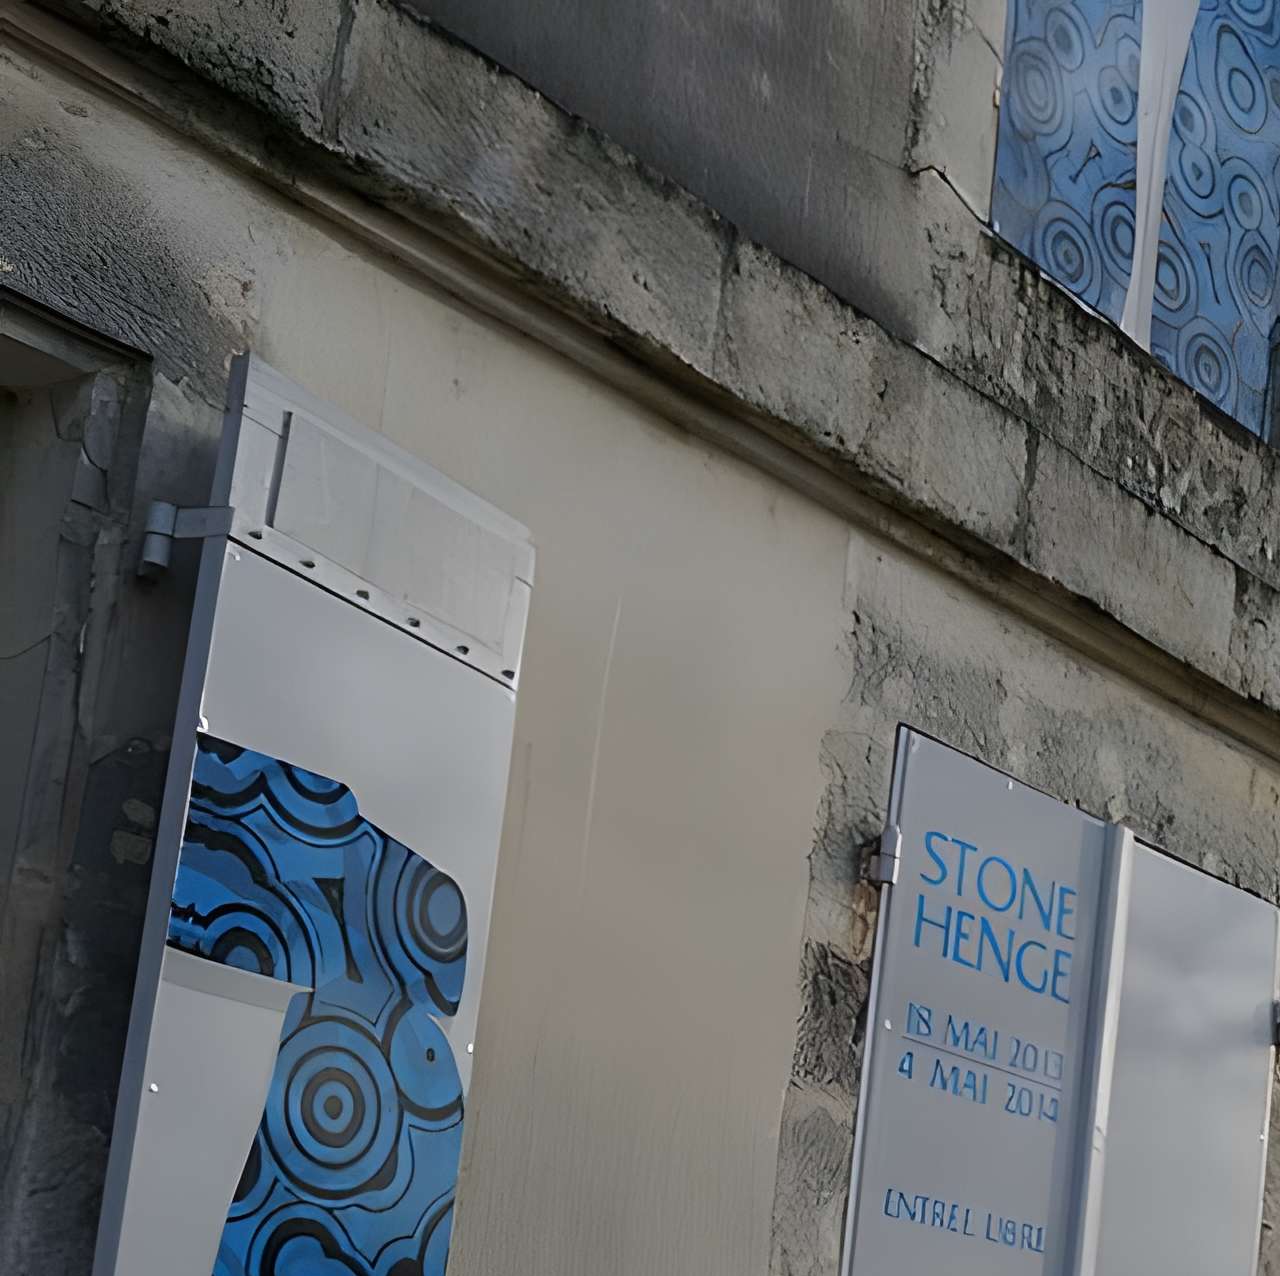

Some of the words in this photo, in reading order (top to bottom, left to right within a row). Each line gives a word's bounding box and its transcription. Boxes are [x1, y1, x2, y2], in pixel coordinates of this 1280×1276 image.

[920, 831, 1077, 940] STONE
[914, 894, 1073, 1004] HENGE
[944, 1014, 998, 1060] MAI
[929, 1058, 988, 1105] MAI
